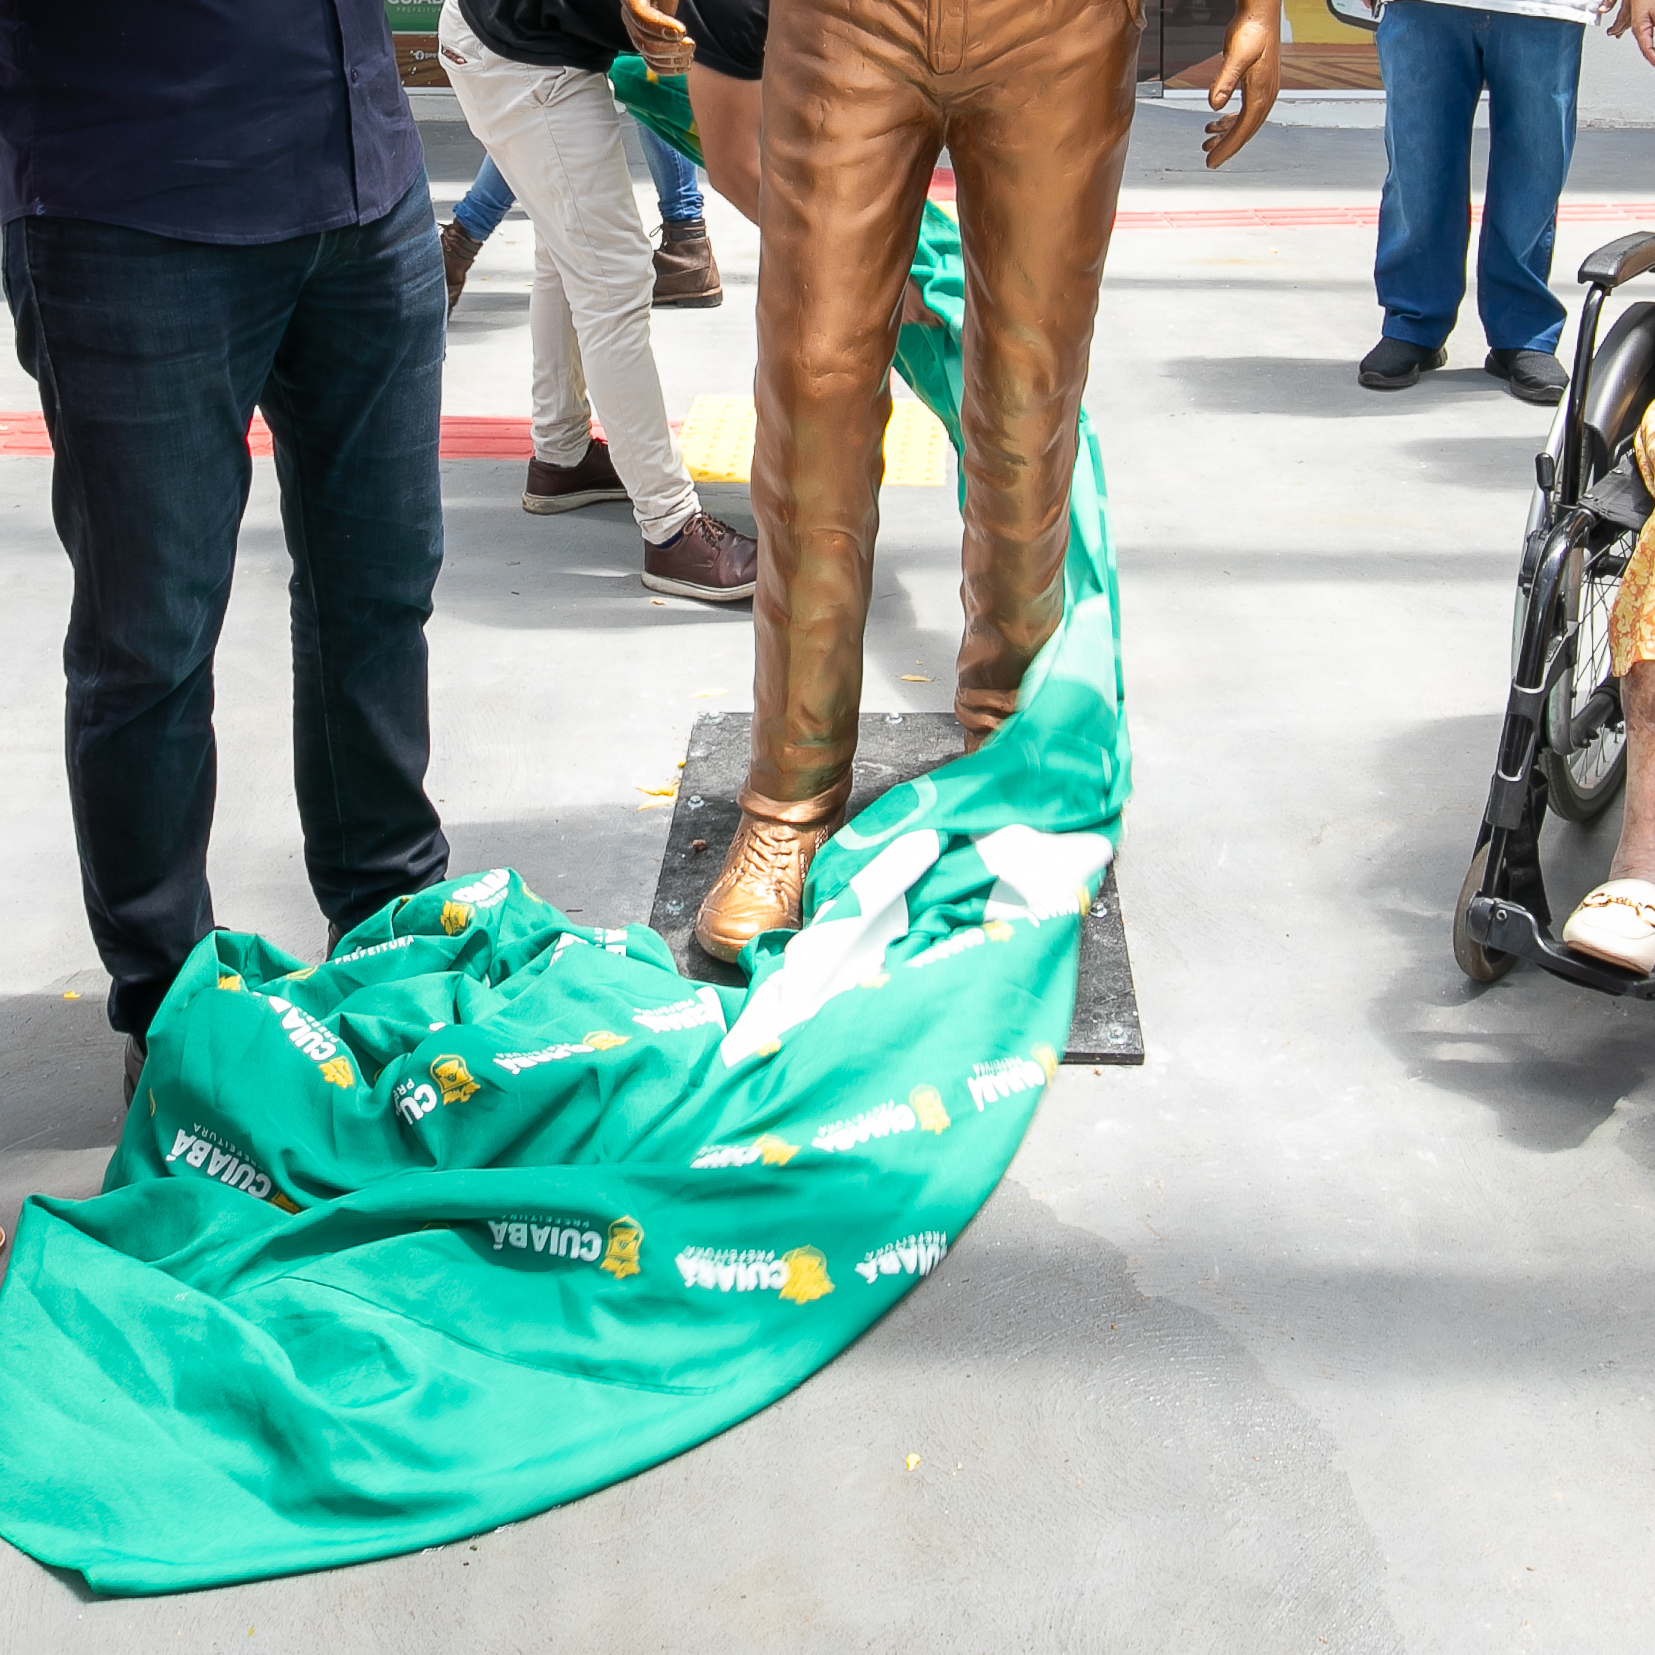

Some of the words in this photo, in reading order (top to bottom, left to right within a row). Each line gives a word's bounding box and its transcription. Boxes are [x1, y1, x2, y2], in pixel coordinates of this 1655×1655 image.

[165, 1128, 273, 1199] CUIABÁ
[487, 1220, 603, 1263] CUIABÁ
[674, 1252, 791, 1294] CUIABÁ
